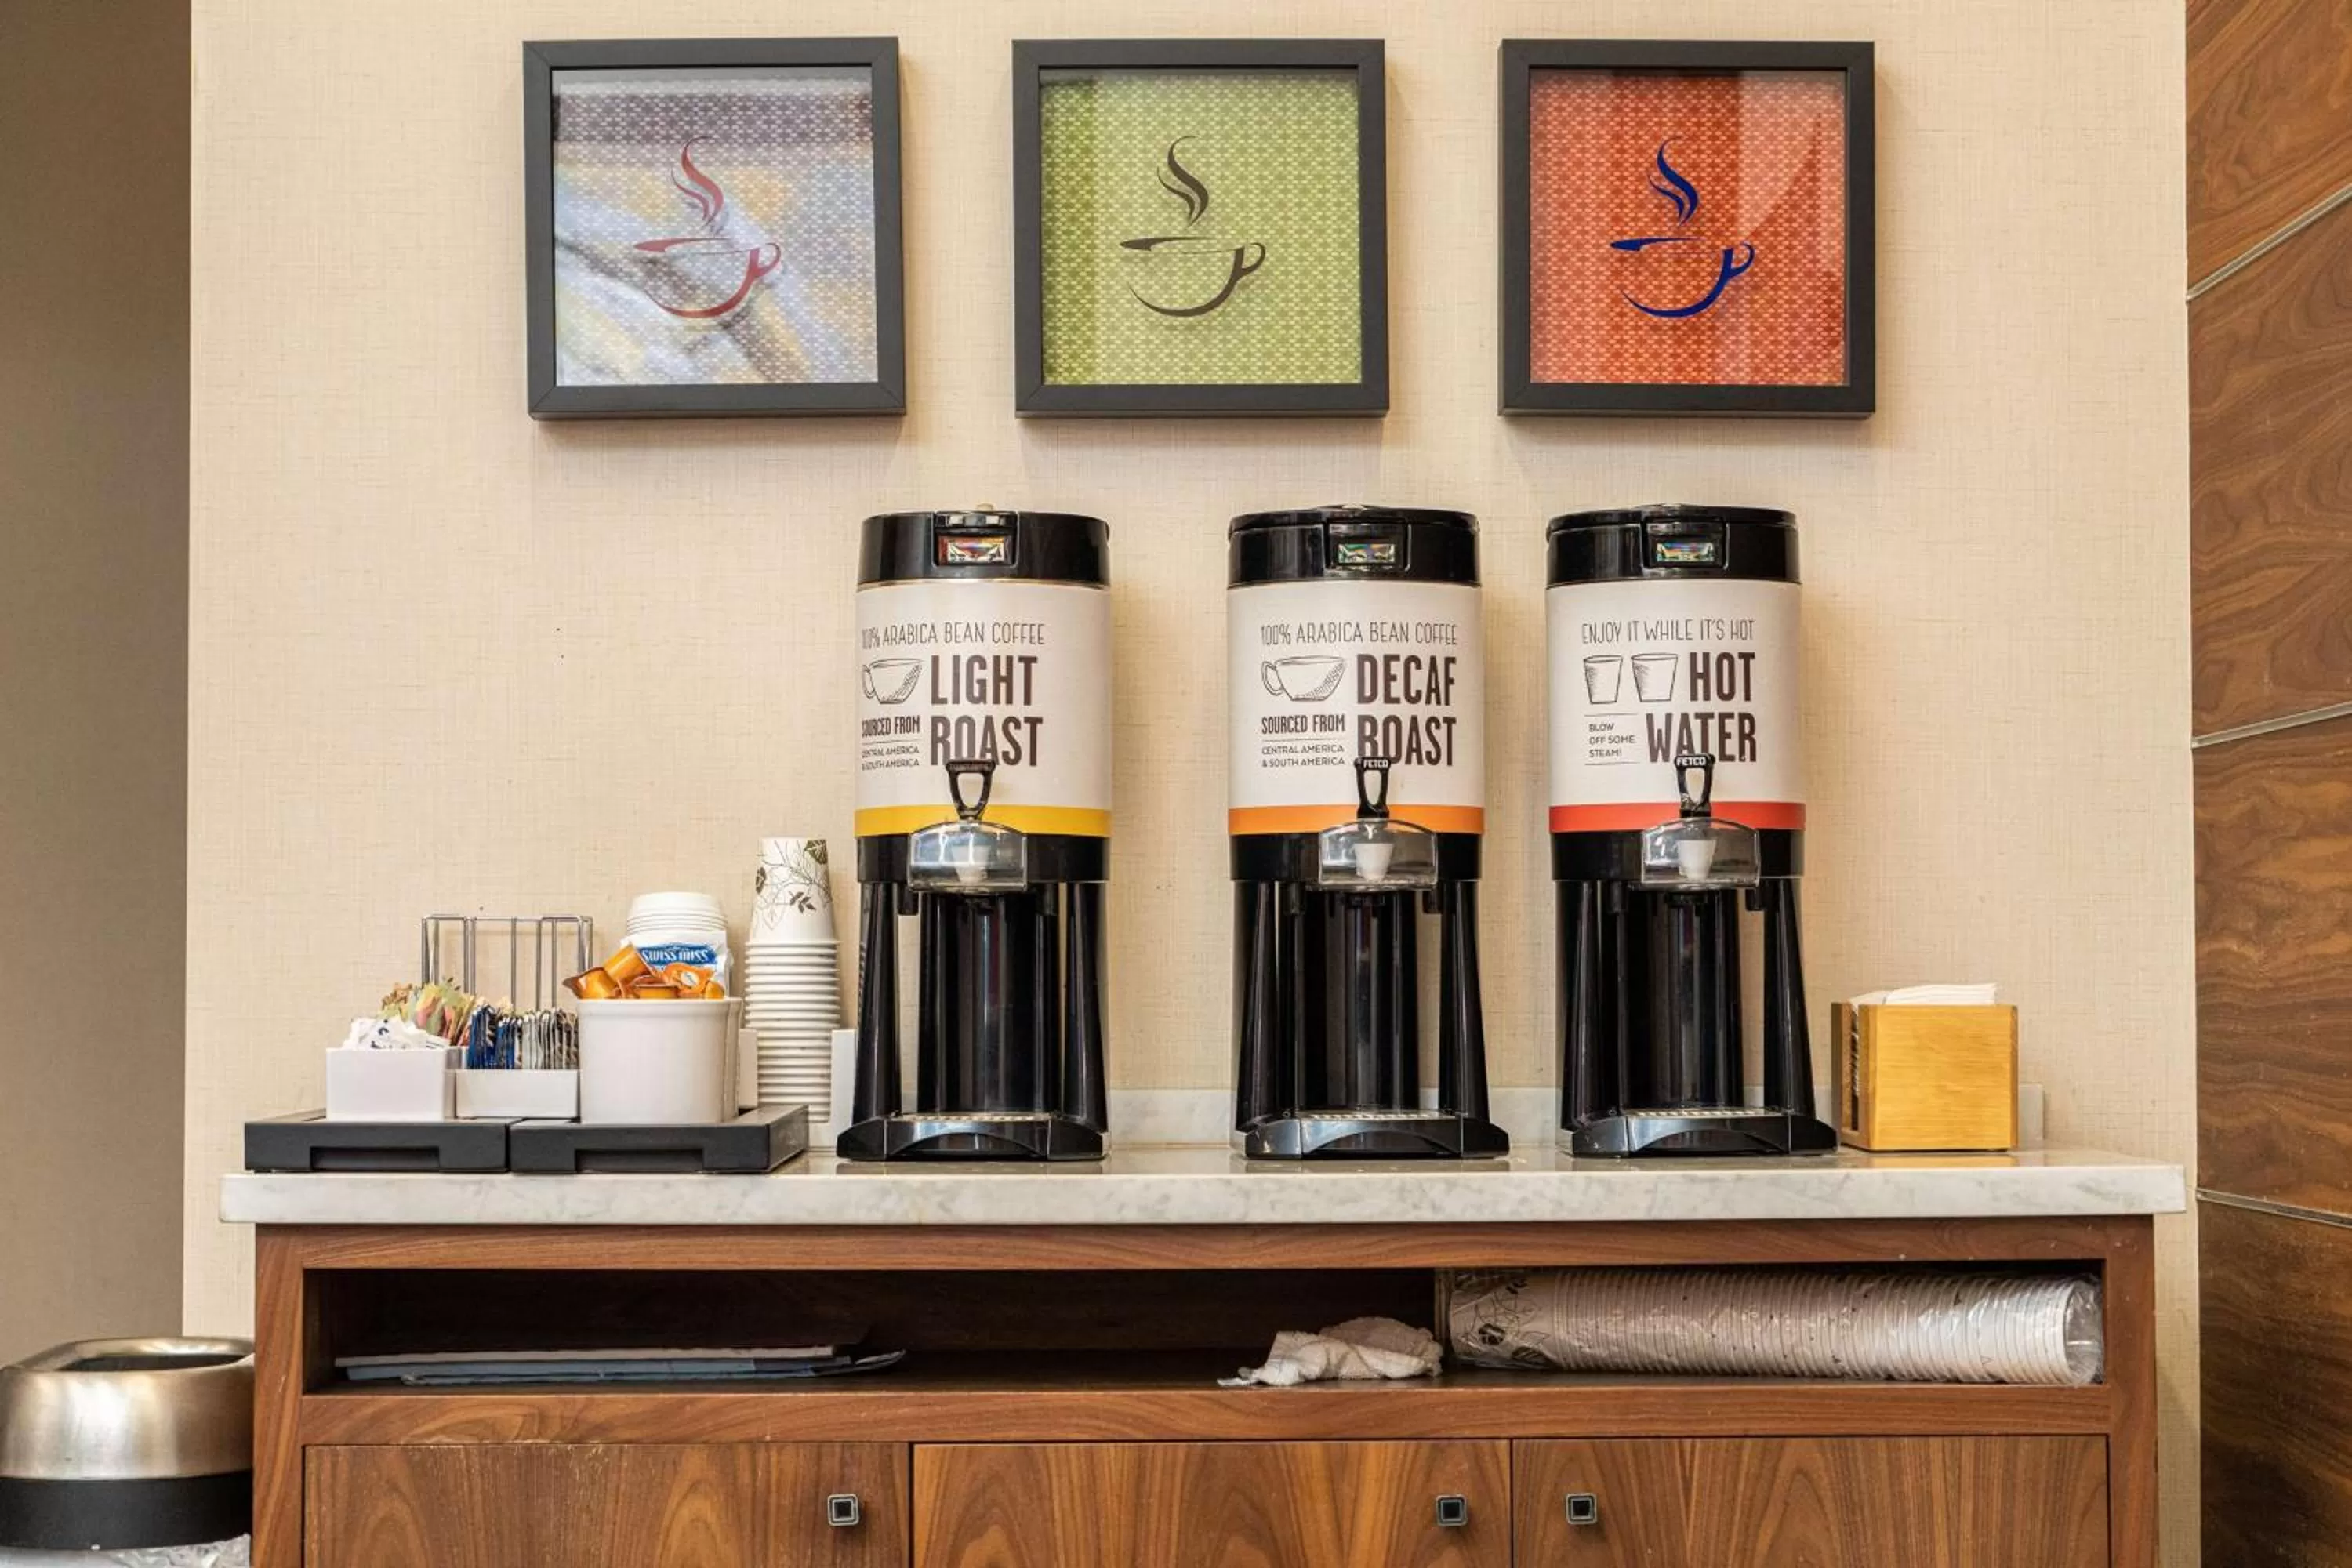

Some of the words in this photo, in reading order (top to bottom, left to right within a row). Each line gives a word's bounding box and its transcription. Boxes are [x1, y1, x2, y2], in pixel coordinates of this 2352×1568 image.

[883, 622, 938, 646] ARABICA
[944, 622, 985, 643] BEAN
[992, 622, 1045, 644] COFFEE
[1261, 623, 1291, 645] 100%
[1295, 622, 1363, 644] ARABICA
[1370, 622, 1410, 643] BEAN
[1415, 622, 1457, 645] COFFEE
[1582, 622, 1622, 644] ENJOY
[1628, 620, 1640, 641] IT
[1644, 619, 1693, 641] WHILE
[1700, 619, 1725, 641] IT'S
[1730, 619, 1755, 641] HOT
[931, 654, 1039, 706] LIGHT
[1356, 653, 1457, 706] DECAF
[1690, 652, 1756, 702] HOT
[895, 715, 920, 734] FROM
[1261, 715, 1308, 735] SOURCED
[1313, 713, 1346, 732] FROM
[1588, 723, 1615, 732] BLOW
[931, 714, 1044, 767] ROAST
[1356, 714, 1457, 766] ROAST
[1588, 736, 1606, 745] OFF
[1608, 735, 1635, 744] SOME
[1646, 712, 1757, 762] WATER
[886, 746, 920, 755] AMERICA
[1261, 745, 1298, 755] CENTRAL
[1301, 744, 1345, 753] AMERICA
[1588, 749, 1622, 757] STEAM!
[886, 758, 920, 768] AMERICA
[1262, 759, 1268, 768] &
[1269, 758, 1299, 767] SOUTH
[1301, 757, 1345, 766] AMERICA
[1676, 757, 1707, 766] FETCO
